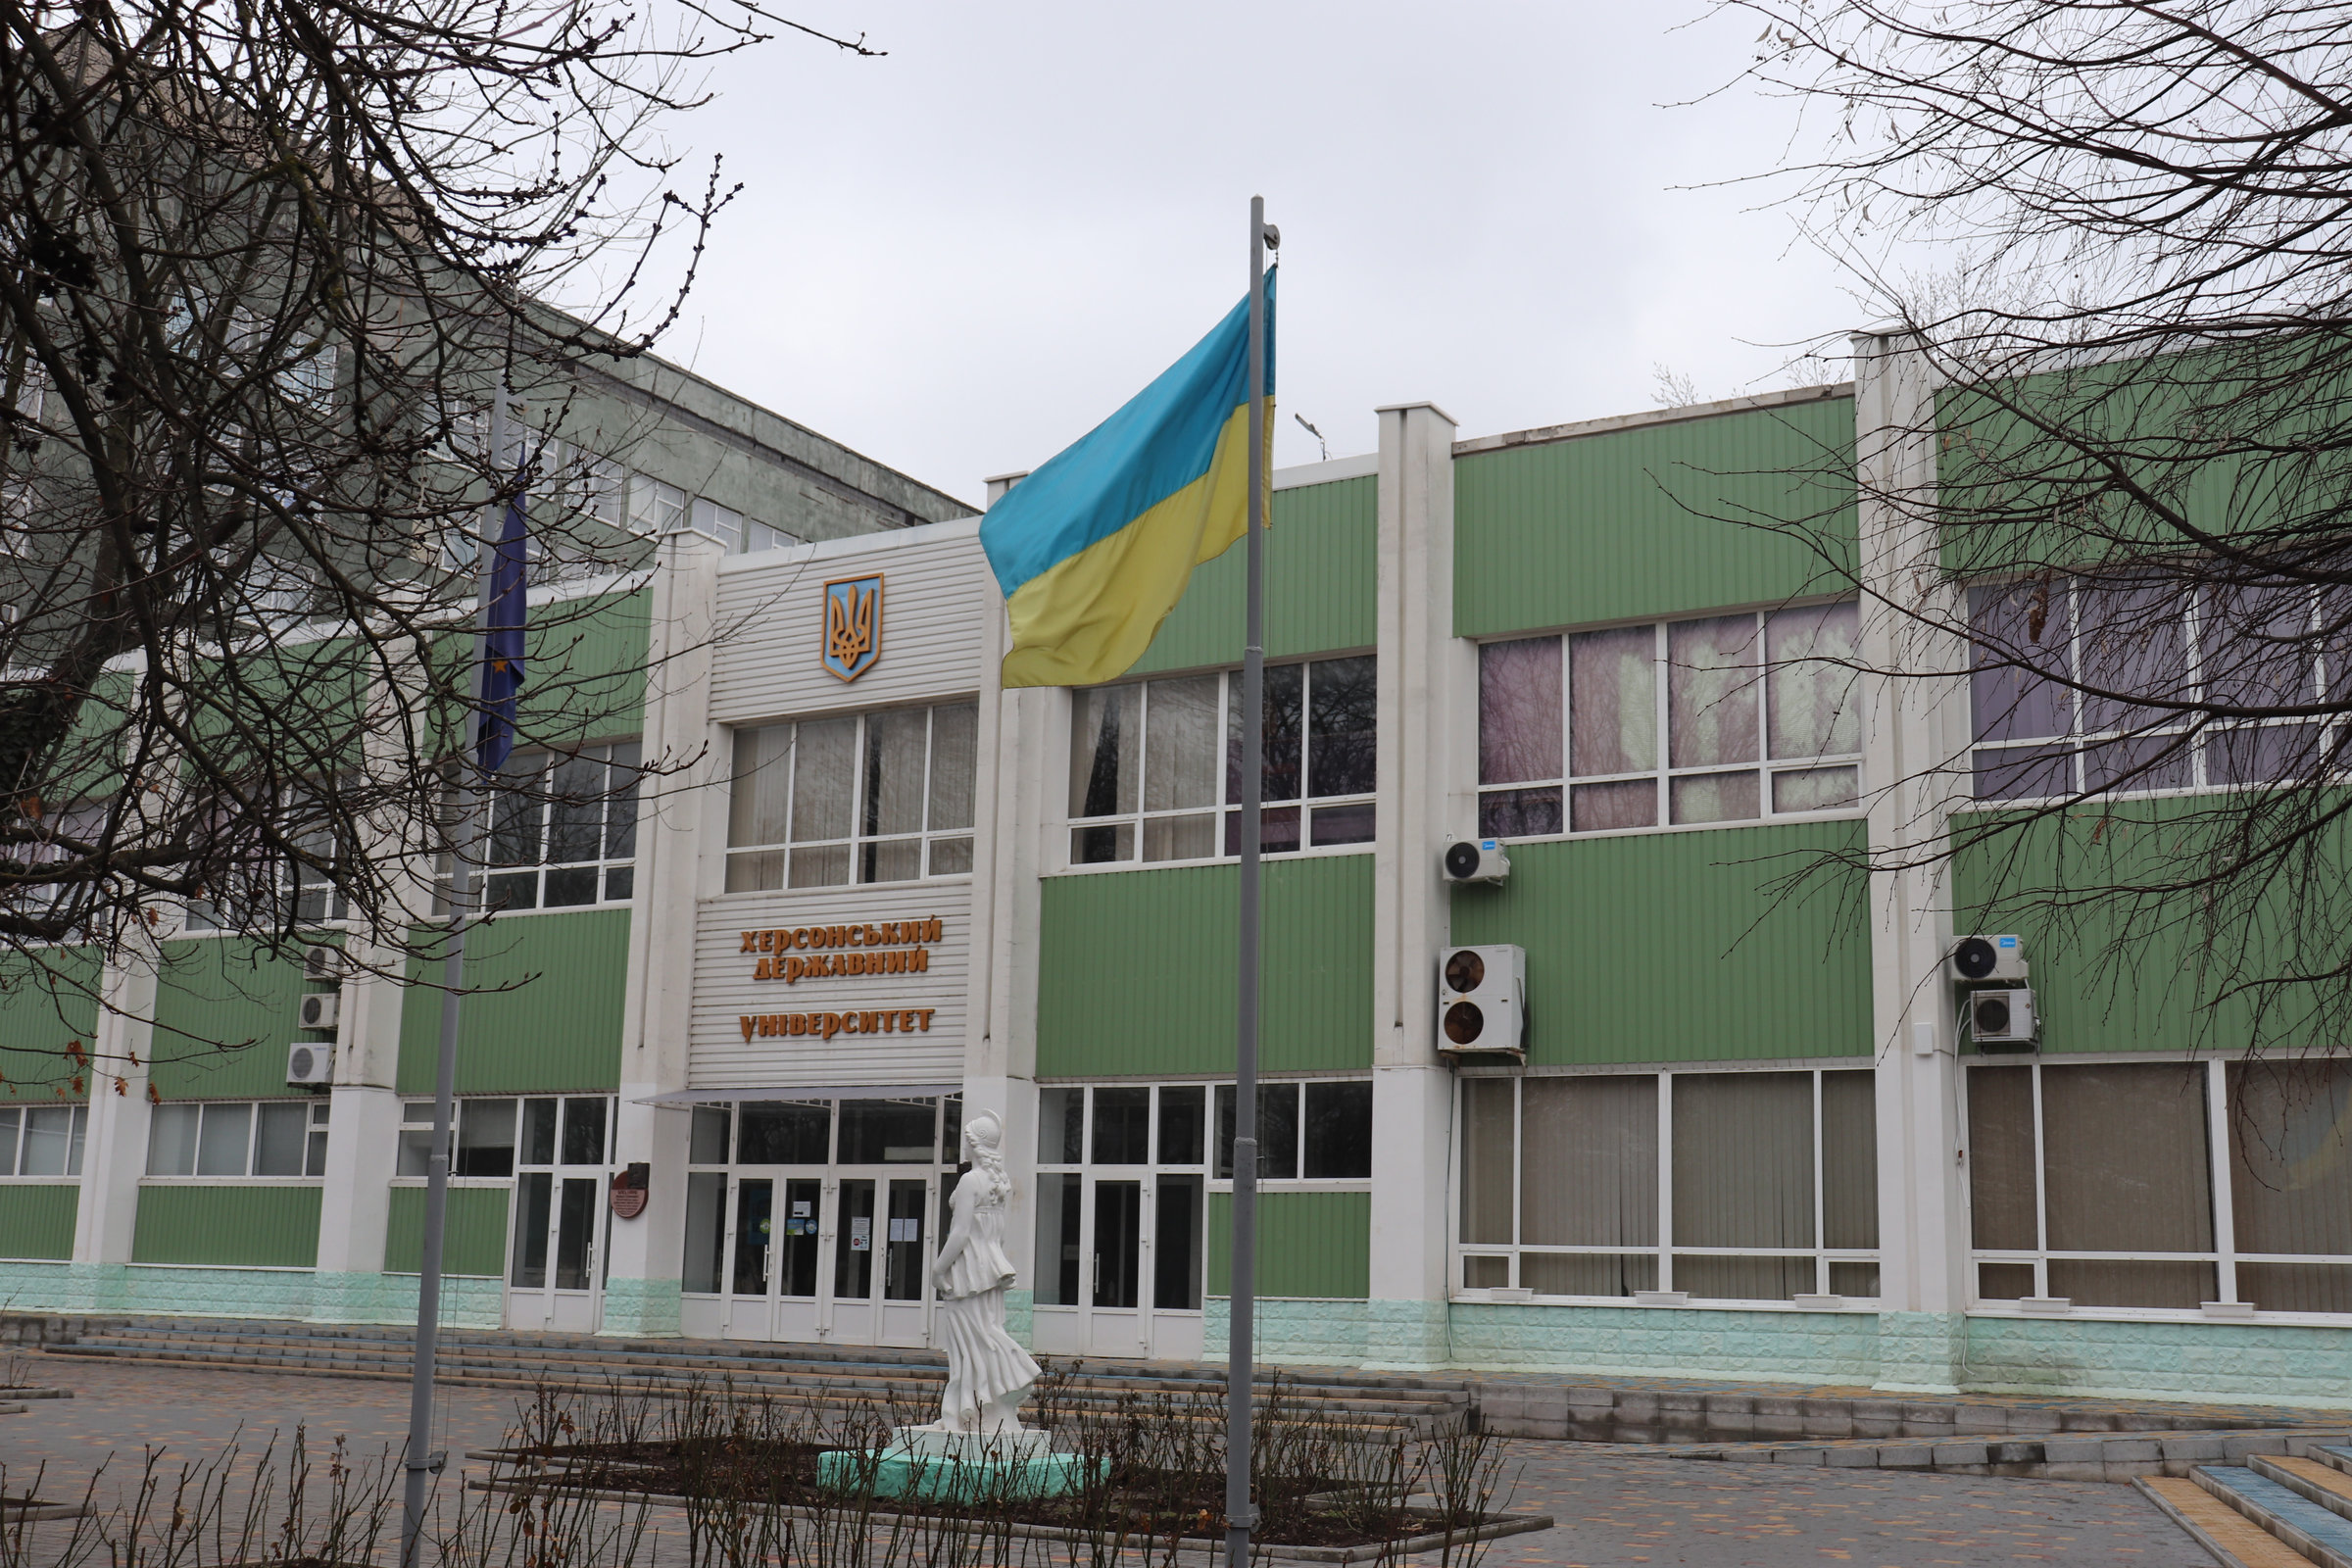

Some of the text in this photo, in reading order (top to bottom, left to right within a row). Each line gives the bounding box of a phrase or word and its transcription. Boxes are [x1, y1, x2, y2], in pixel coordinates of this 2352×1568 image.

[740, 914, 942, 956] ХЕРСОНСЬКИЙ
[753, 945, 929, 983] ДЕРЖАВНИЙ
[739, 1008, 935, 1043] УНІВЕРСИТЕТ
